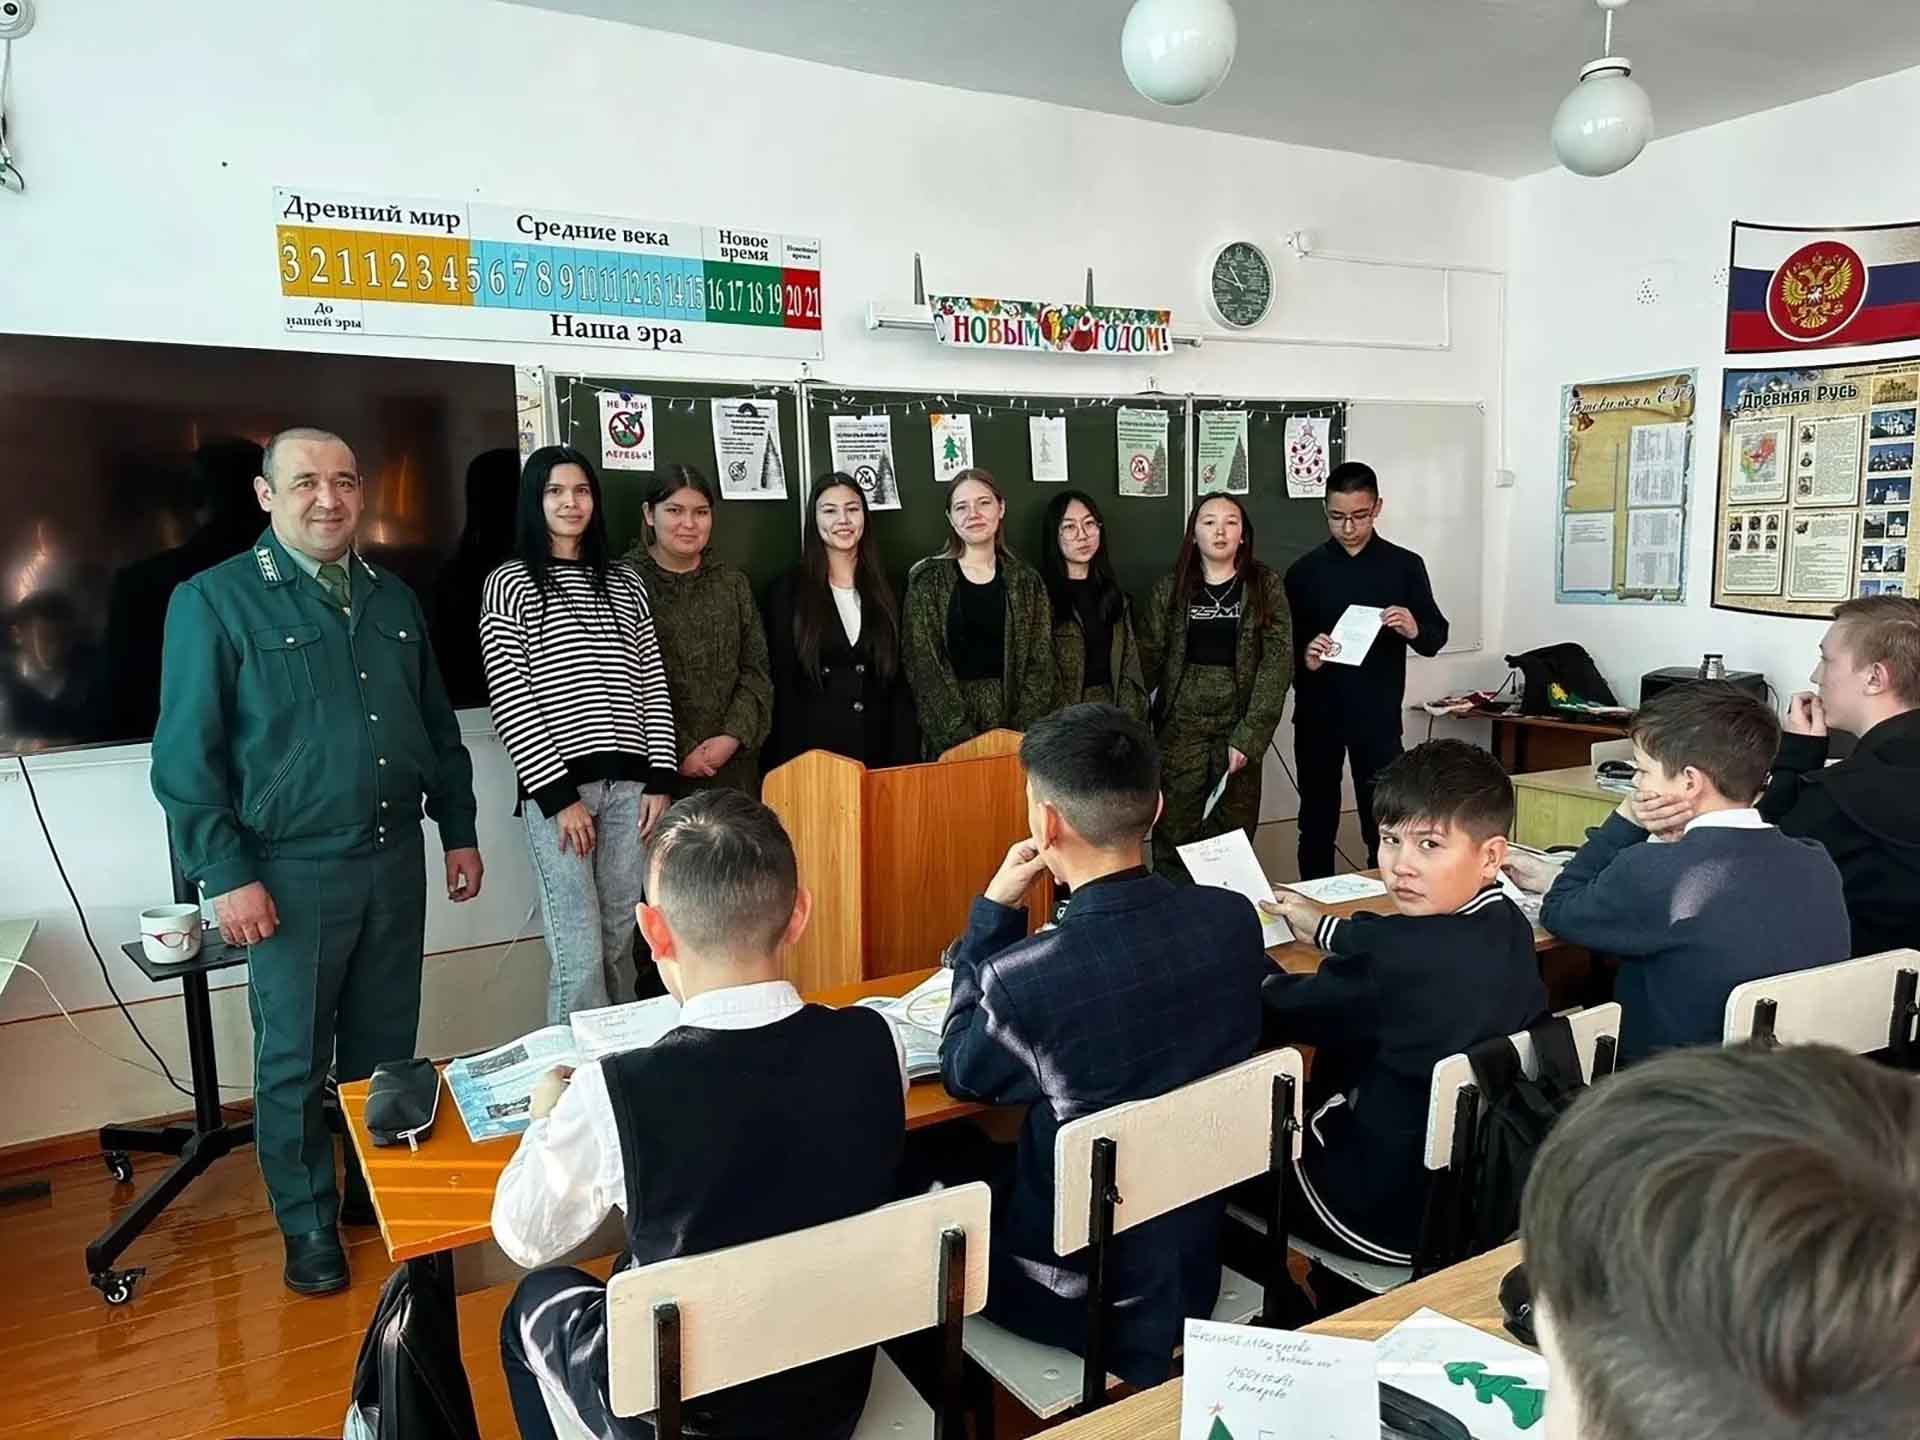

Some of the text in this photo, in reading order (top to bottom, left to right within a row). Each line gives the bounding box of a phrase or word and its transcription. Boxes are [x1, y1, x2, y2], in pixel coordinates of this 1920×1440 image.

[283, 194, 460, 233] Древний мир
[516, 214, 670, 246] Средние века
[719, 230, 768, 248] Новое
[720, 247, 769, 262] время
[282, 243, 820, 318] 3 2 1 1 2 3 4 5 6 7 8 9 10 11 12 13 14 15 16 17 18 19 20 21
[314, 302, 334, 315] До
[286, 316, 362, 331] нашей эры
[550, 313, 683, 350] Наша эра
[954, 315, 1040, 347] НОВЫМ
[1093, 320, 1168, 352] ГОДОМ!
[607, 400, 620, 409] НЕ
[1742, 385, 1857, 409] Древняя Русь
